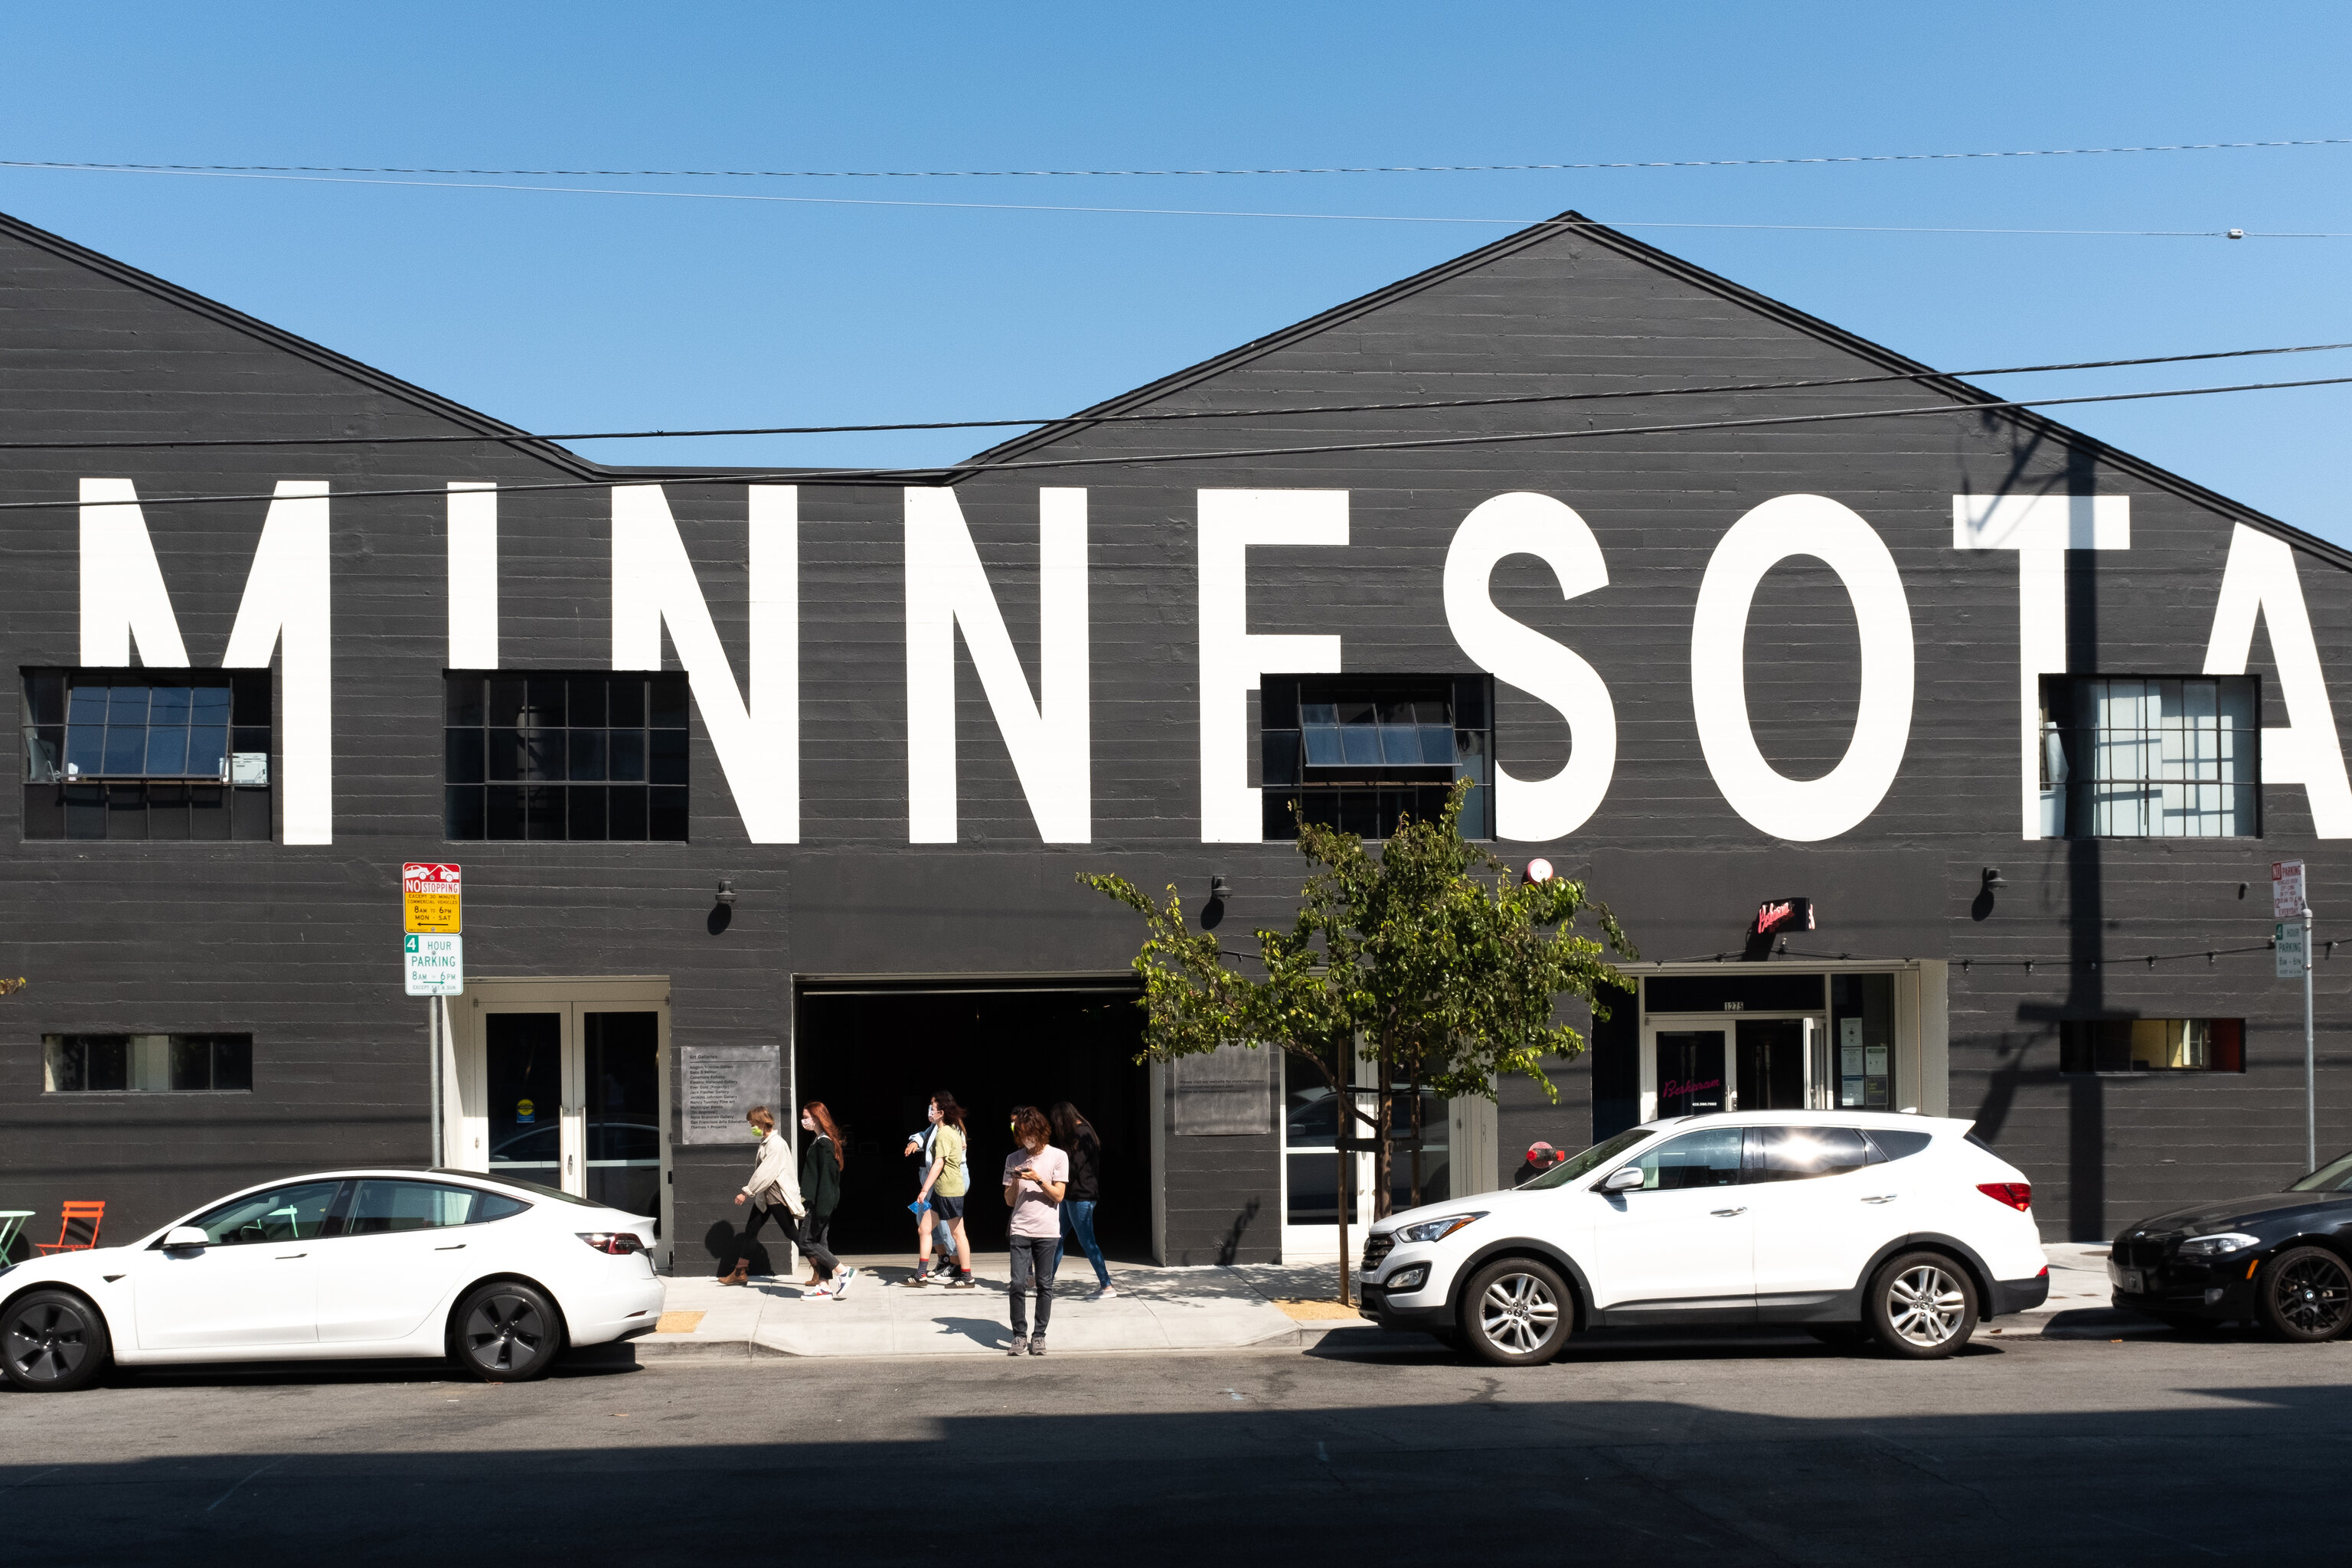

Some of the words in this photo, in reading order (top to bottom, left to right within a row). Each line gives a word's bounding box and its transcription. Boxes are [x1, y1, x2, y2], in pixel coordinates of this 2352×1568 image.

[79, 478, 2352, 847] MINNESOTA
[2272, 864, 2281, 879] NO
[2282, 866, 2301, 877] PARKING
[406, 880, 421, 893] NO
[423, 883, 458, 893] STOPPING
[2278, 907, 2298, 916] EVERYDAY
[2287, 929, 2300, 937] HOUR
[407, 937, 416, 951] 4
[427, 941, 452, 950] HOUR
[2278, 942, 2301, 952] PARKING
[411, 956, 456, 967] PARKING
[412, 971, 427, 980] 8AM
[440, 972, 456, 980] 6PM
[1726, 1002, 1743, 1011] 1275
[1663, 1079, 1720, 1099] Besharam
